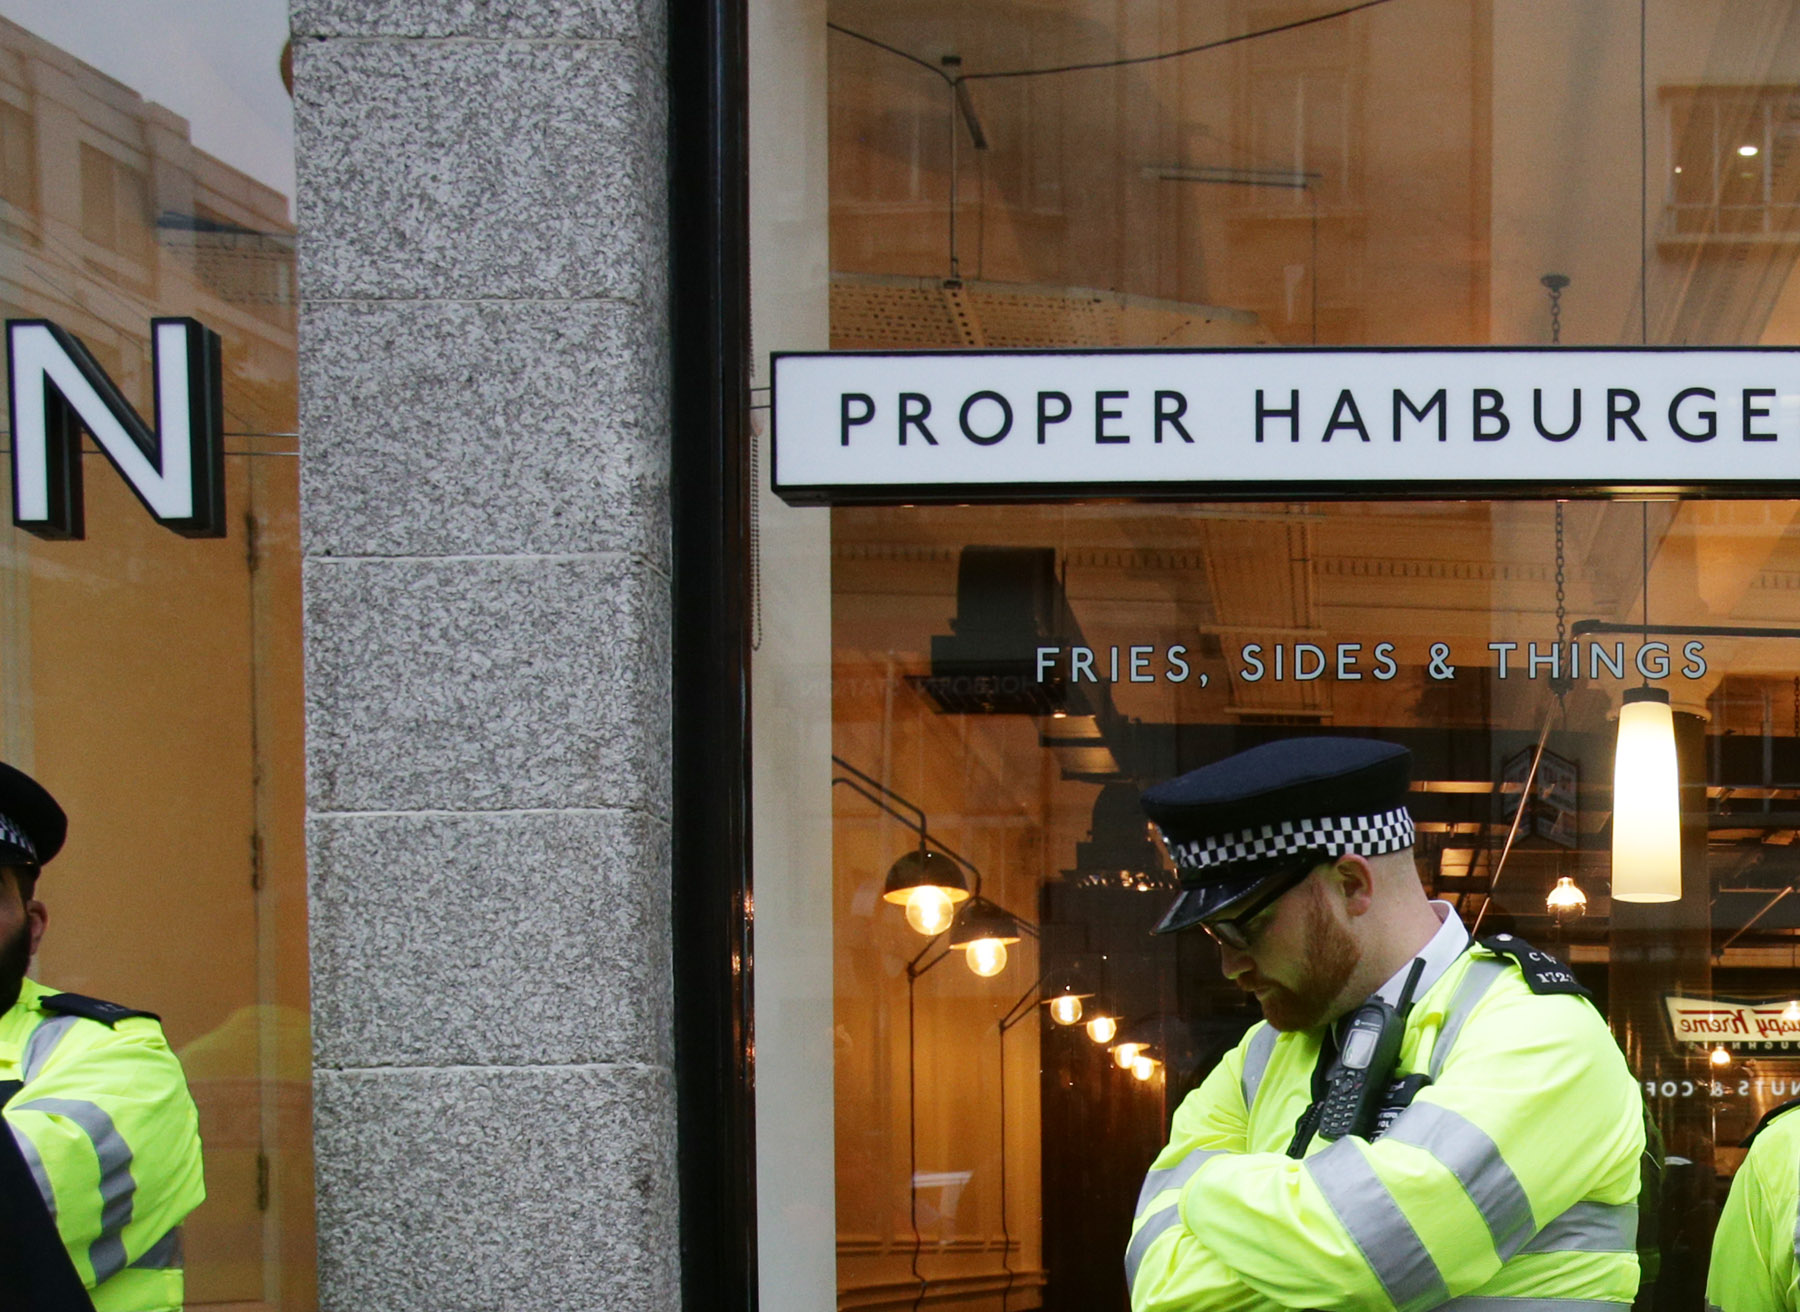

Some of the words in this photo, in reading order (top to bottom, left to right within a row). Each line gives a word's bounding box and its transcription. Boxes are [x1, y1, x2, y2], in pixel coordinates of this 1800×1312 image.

[840, 390, 1195, 446] PROPER
[1035, 645, 1209, 688] FRIES,
[1241, 642, 1399, 681] SIDES
[1427, 642, 1456, 680] &
[1489, 640, 1708, 680] THINGS
